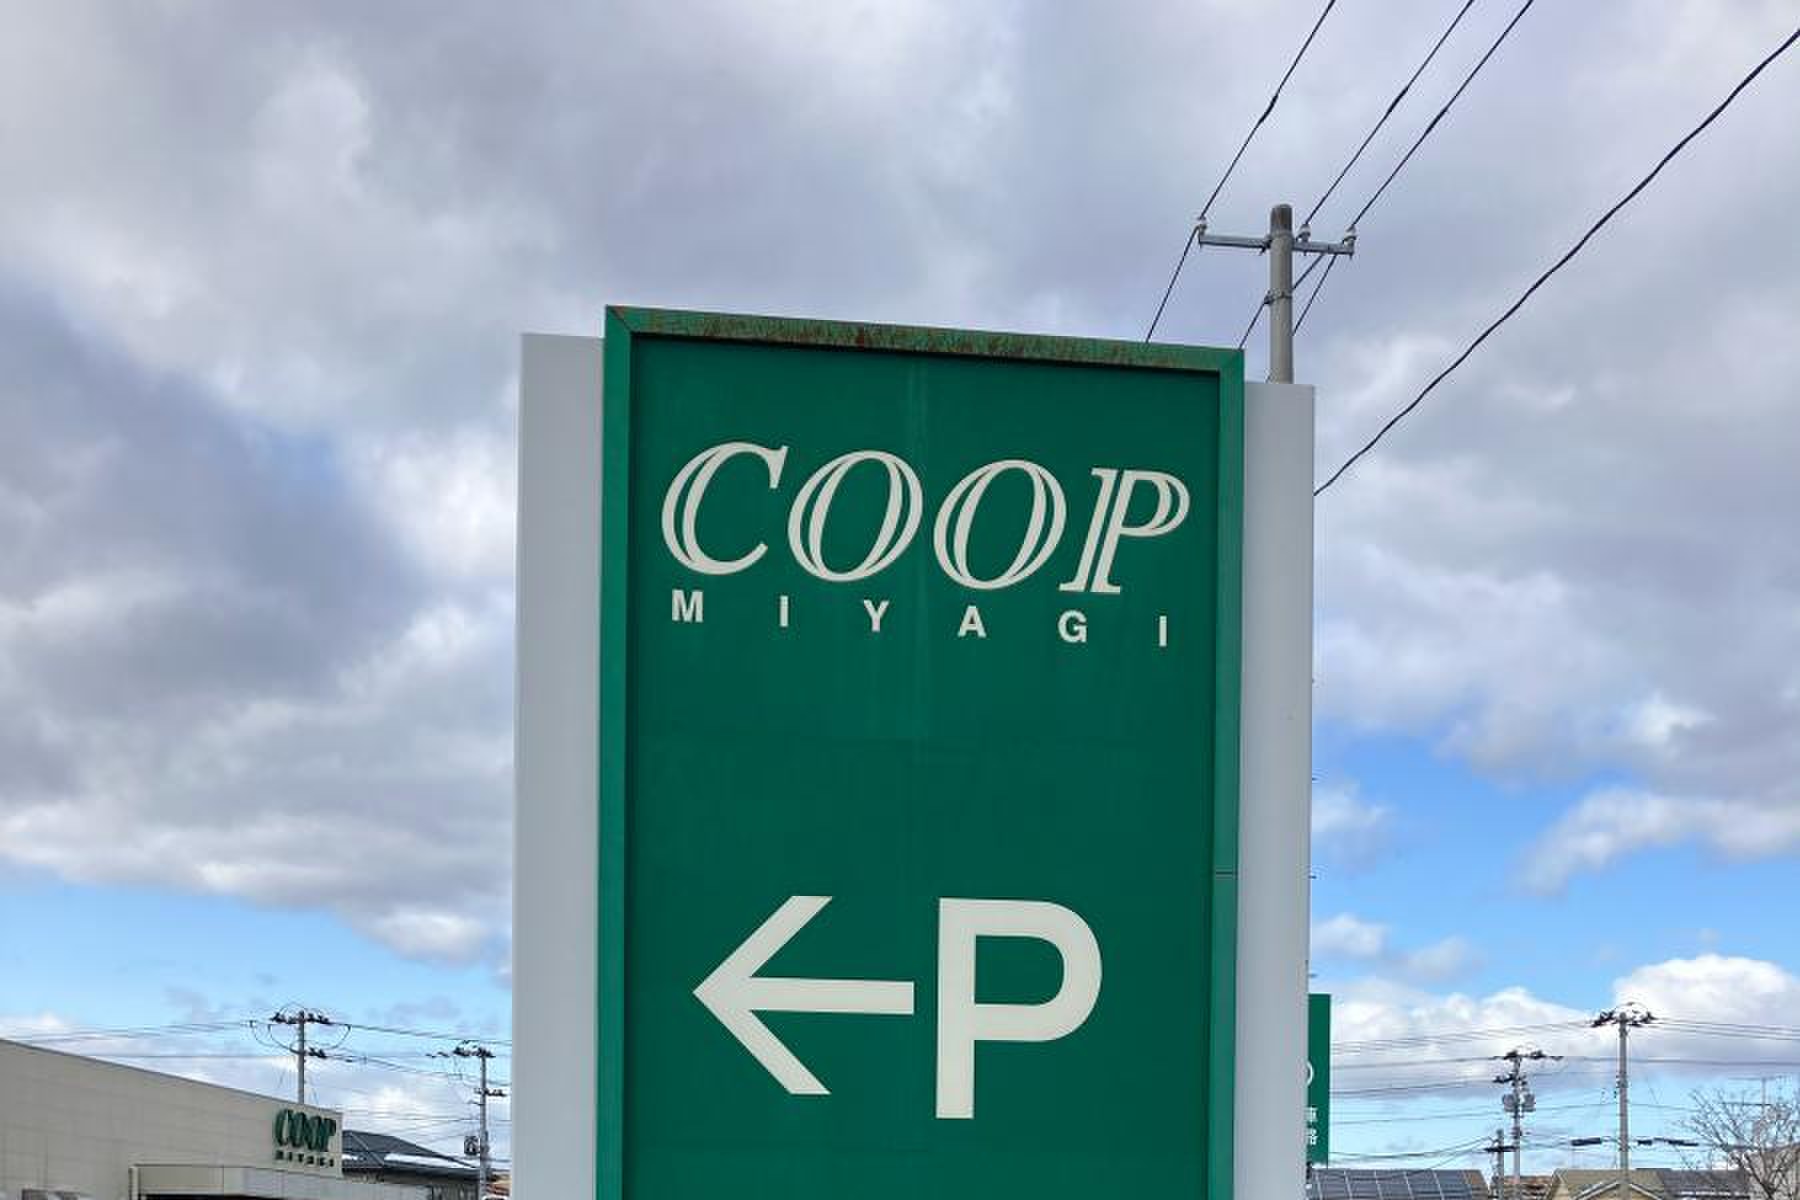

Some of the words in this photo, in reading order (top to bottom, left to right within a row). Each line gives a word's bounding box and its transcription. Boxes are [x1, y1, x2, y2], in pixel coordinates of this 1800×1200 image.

[662, 442, 1190, 594] COOP
[671, 589, 1167, 647] MIYAGI
[936, 897, 1102, 1119] P
